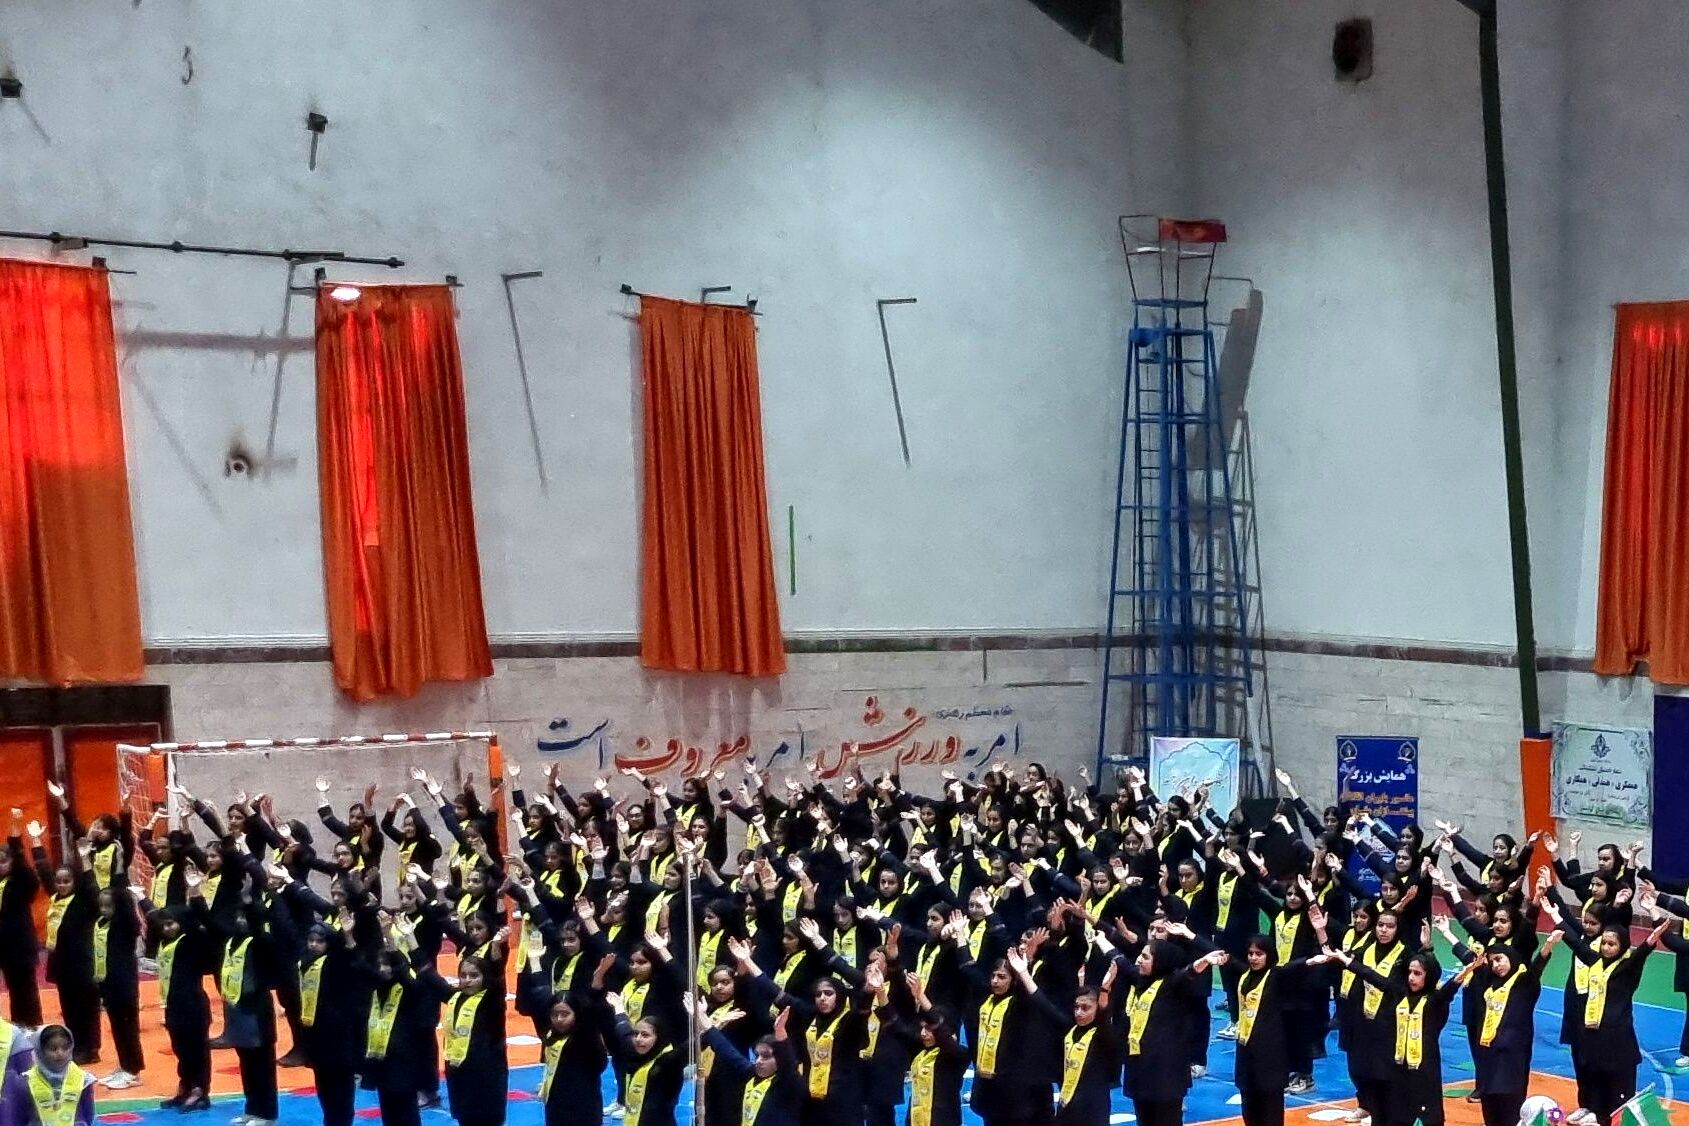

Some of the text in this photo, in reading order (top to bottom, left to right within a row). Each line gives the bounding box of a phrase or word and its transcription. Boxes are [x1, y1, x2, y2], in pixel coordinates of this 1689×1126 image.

[537, 718, 609, 769] است
[615, 736, 749, 782] معروف
[766, 731, 804, 768] امر
[815, 696, 960, 780] ورزش
[975, 722, 1020, 768] امر
[1373, 770, 1407, 784] همایش
